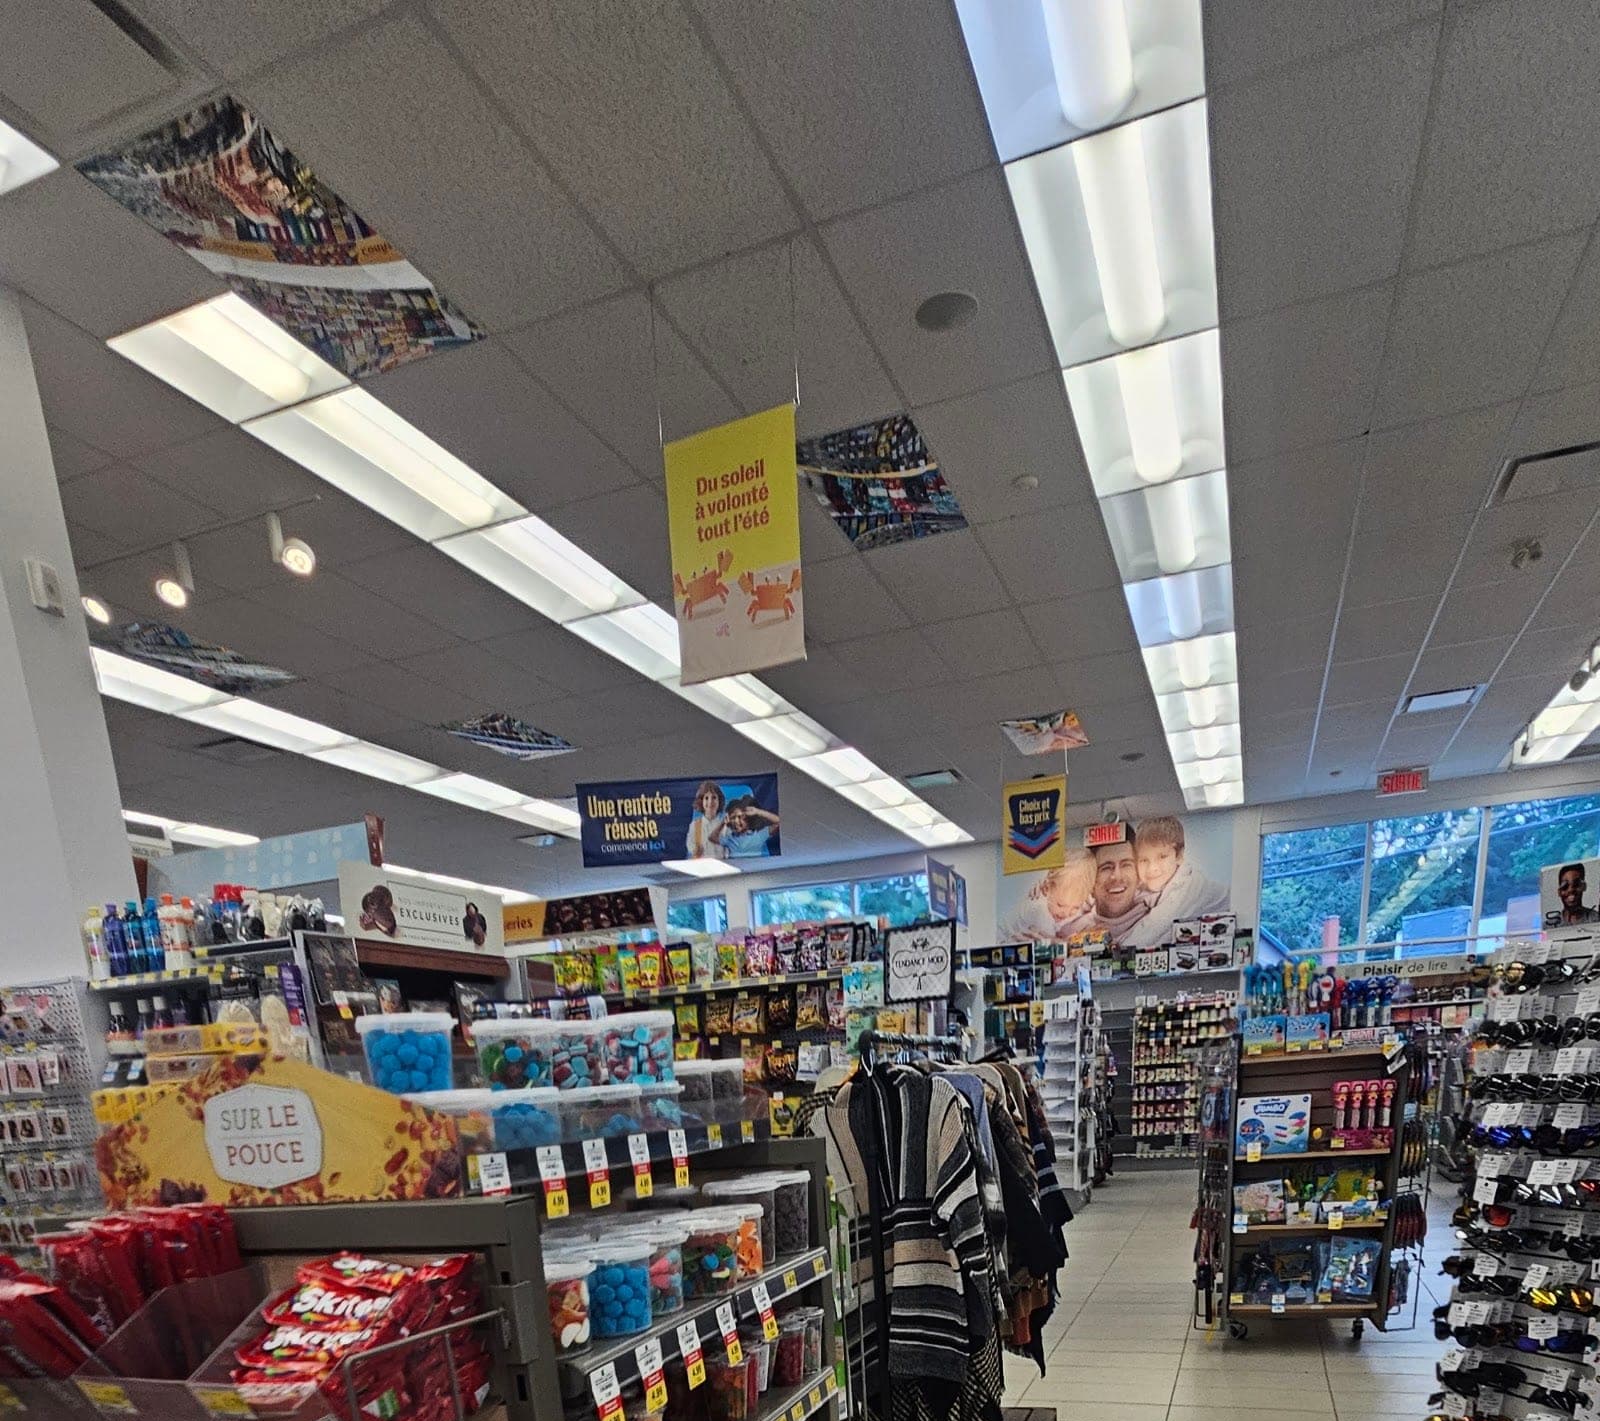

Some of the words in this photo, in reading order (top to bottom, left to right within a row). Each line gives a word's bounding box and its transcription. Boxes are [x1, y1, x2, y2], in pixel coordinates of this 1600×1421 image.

[696, 472, 719, 497] Du
[720, 459, 765, 488] soleil
[695, 500, 705, 521] à
[706, 485, 769, 518] volonté
[697, 521, 731, 542] tout
[733, 507, 769, 534] l'été
[1383, 771, 1423, 794] SORTIE
[586, 795, 615, 818] Une
[617, 791, 671, 816] rentrée
[1019, 798, 1041, 813] Choix
[1041, 797, 1050, 809] et
[604, 817, 659, 841] réussie
[1019, 811, 1033, 825] bas
[1034, 809, 1050, 826] prix
[1088, 823, 1121, 844] SORTIE
[600, 842, 648, 854] commence
[399, 907, 460, 926] EXCLUSIVES
[1363, 964, 1403, 977] Plaisir
[1408, 962, 1424, 974] de
[1428, 961, 1448, 972] lire
[220, 1107, 261, 1132] SUR
[269, 1104, 299, 1129] LE
[226, 1141, 304, 1166] POUCE
